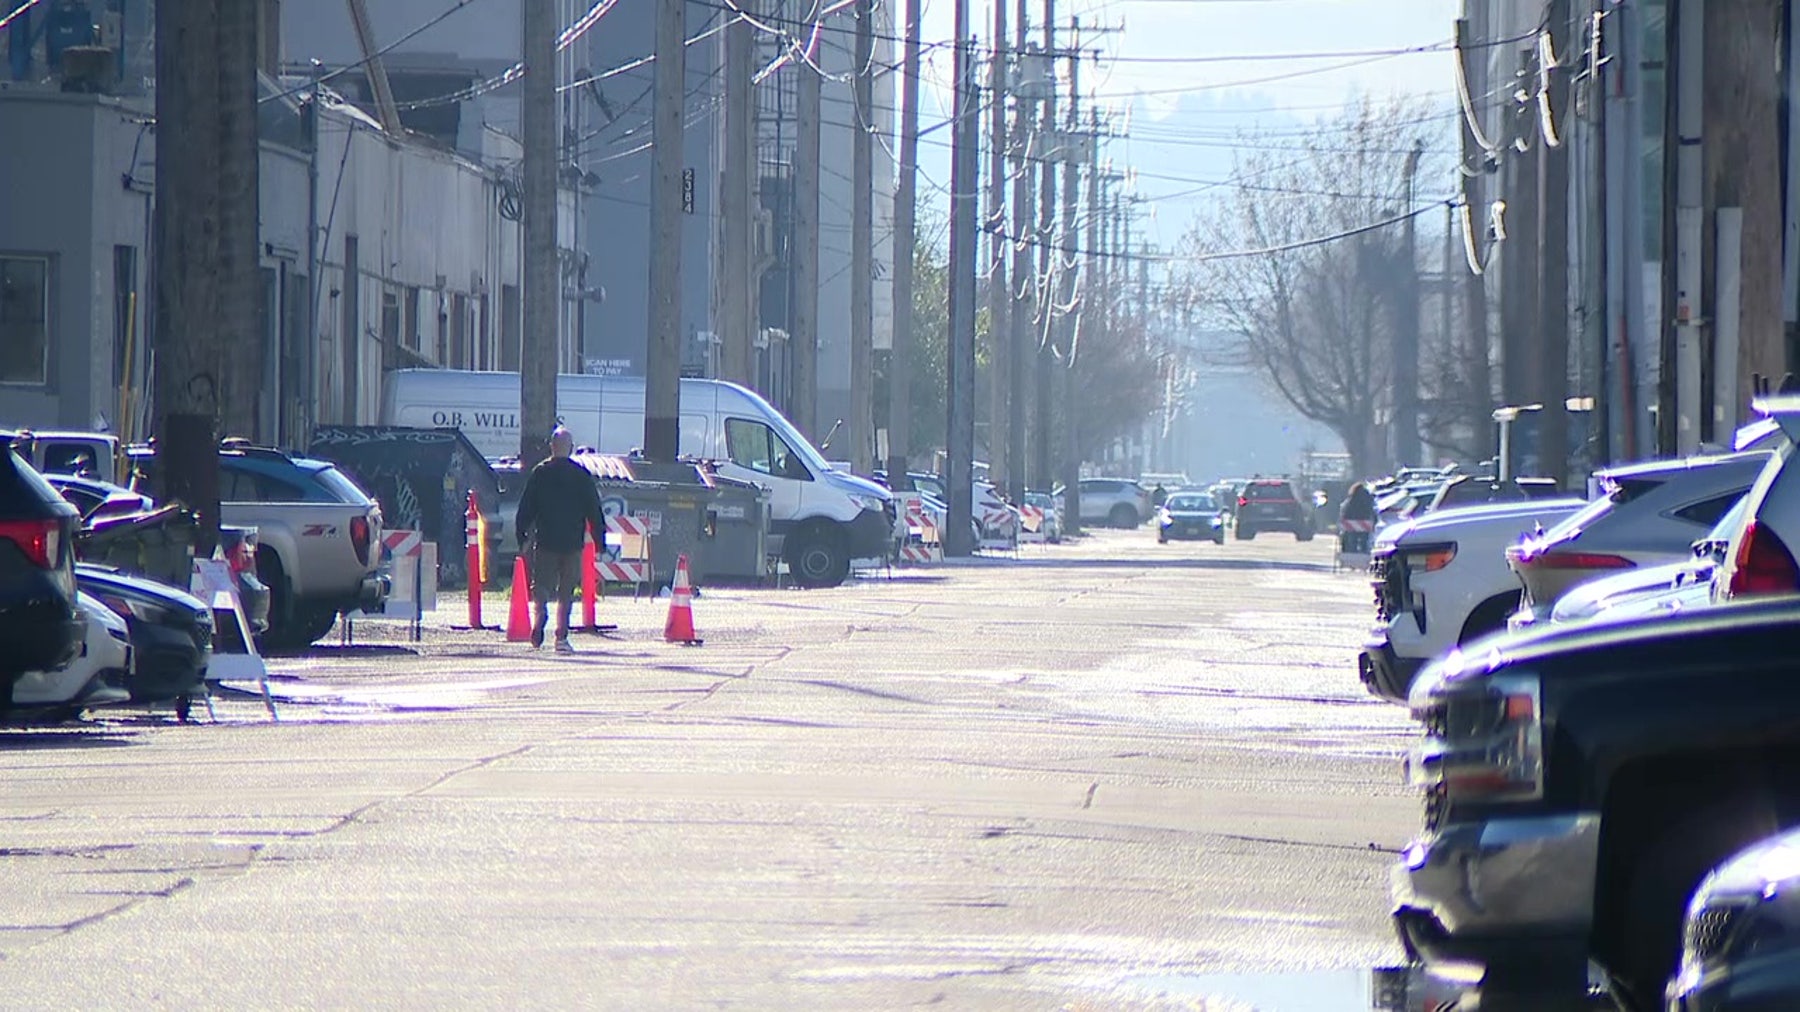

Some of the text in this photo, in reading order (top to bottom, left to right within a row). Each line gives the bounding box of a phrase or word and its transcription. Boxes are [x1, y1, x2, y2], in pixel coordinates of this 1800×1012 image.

[684, 169, 692, 214] 2384
[593, 367, 622, 375] TO PAY
[432, 411, 467, 427] O.B.
